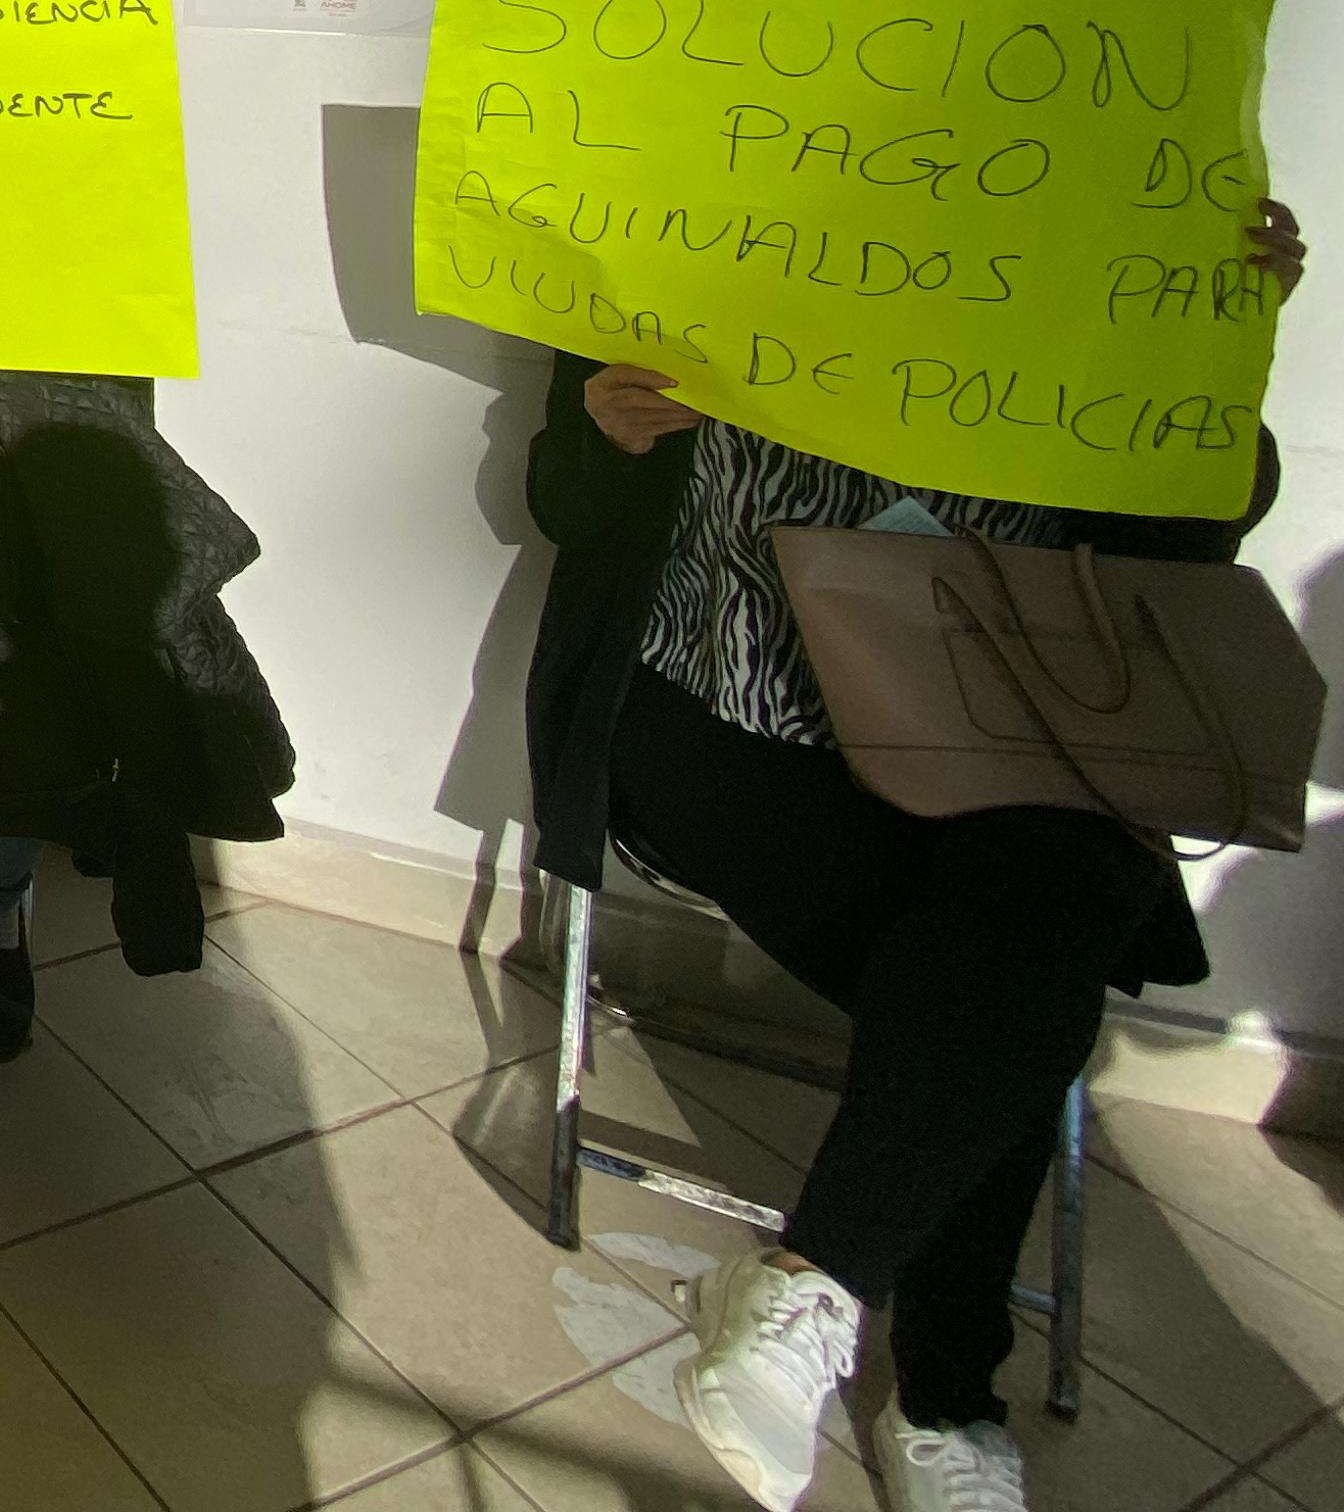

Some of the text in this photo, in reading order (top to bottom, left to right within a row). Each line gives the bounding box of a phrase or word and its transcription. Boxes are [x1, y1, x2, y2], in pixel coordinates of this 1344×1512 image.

[474, 80, 1249, 211] AL PAGO DE
[452, 169, 1266, 324] AGUINALDOS PARA
[447, 243, 1256, 454] VIUDAS DE POLICIAS
